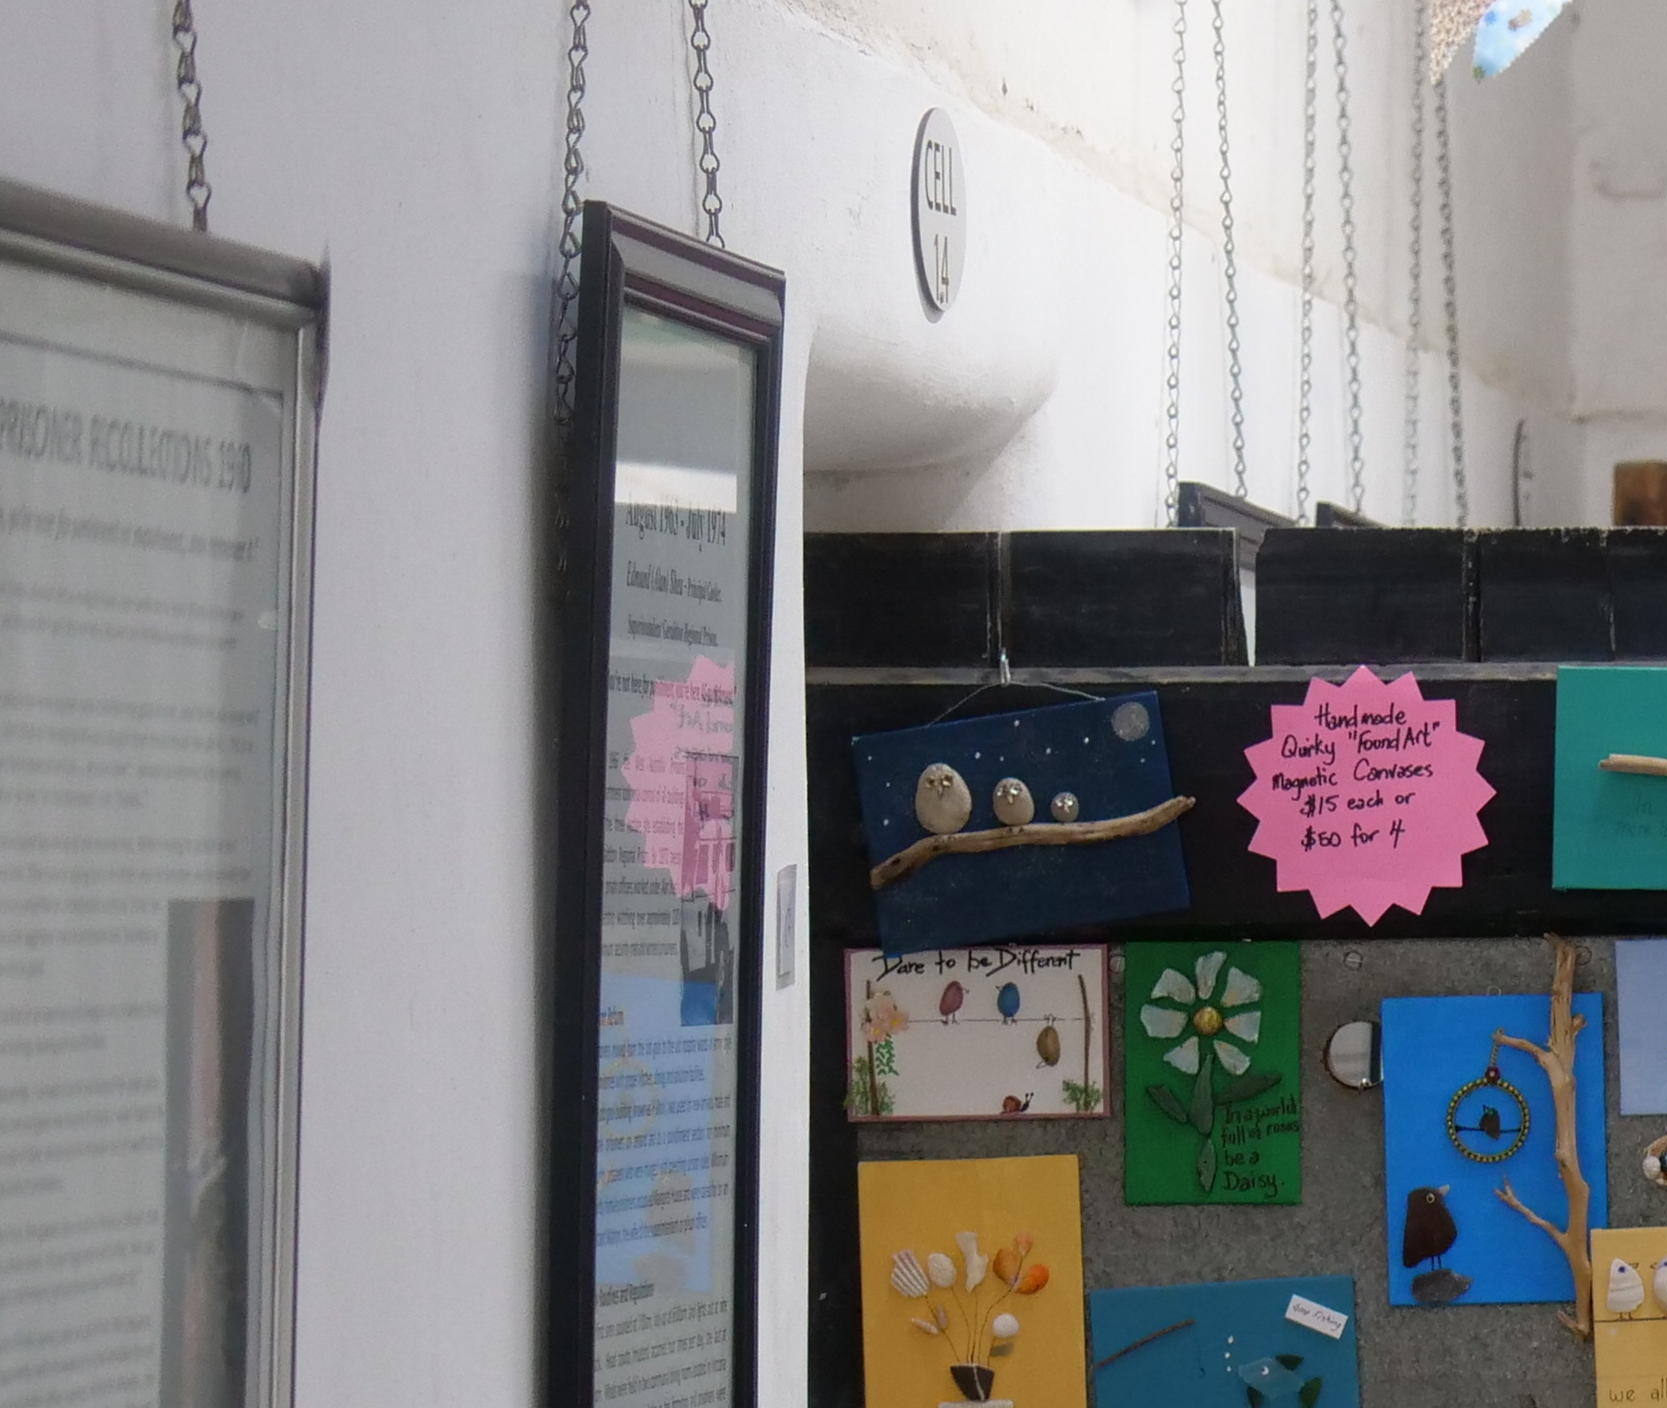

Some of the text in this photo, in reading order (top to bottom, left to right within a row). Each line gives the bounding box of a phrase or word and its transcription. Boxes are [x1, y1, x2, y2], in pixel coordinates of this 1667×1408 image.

[924, 139, 957, 216] CELL
[934, 233, 950, 304] 14
[1314, 702, 1407, 730] Handmade
[1281, 733, 1336, 766] Quirky
[1272, 758, 1434, 800] Magnetic Canvases
[1300, 790, 1416, 818] $15 each or
[1301, 818, 1406, 852] $50 for 4
[872, 948, 1081, 982] Dare to be Different
[1221, 1125, 1245, 1148] full
[1225, 1150, 1246, 1167] be
[1608, 1387, 1636, 1403] we
